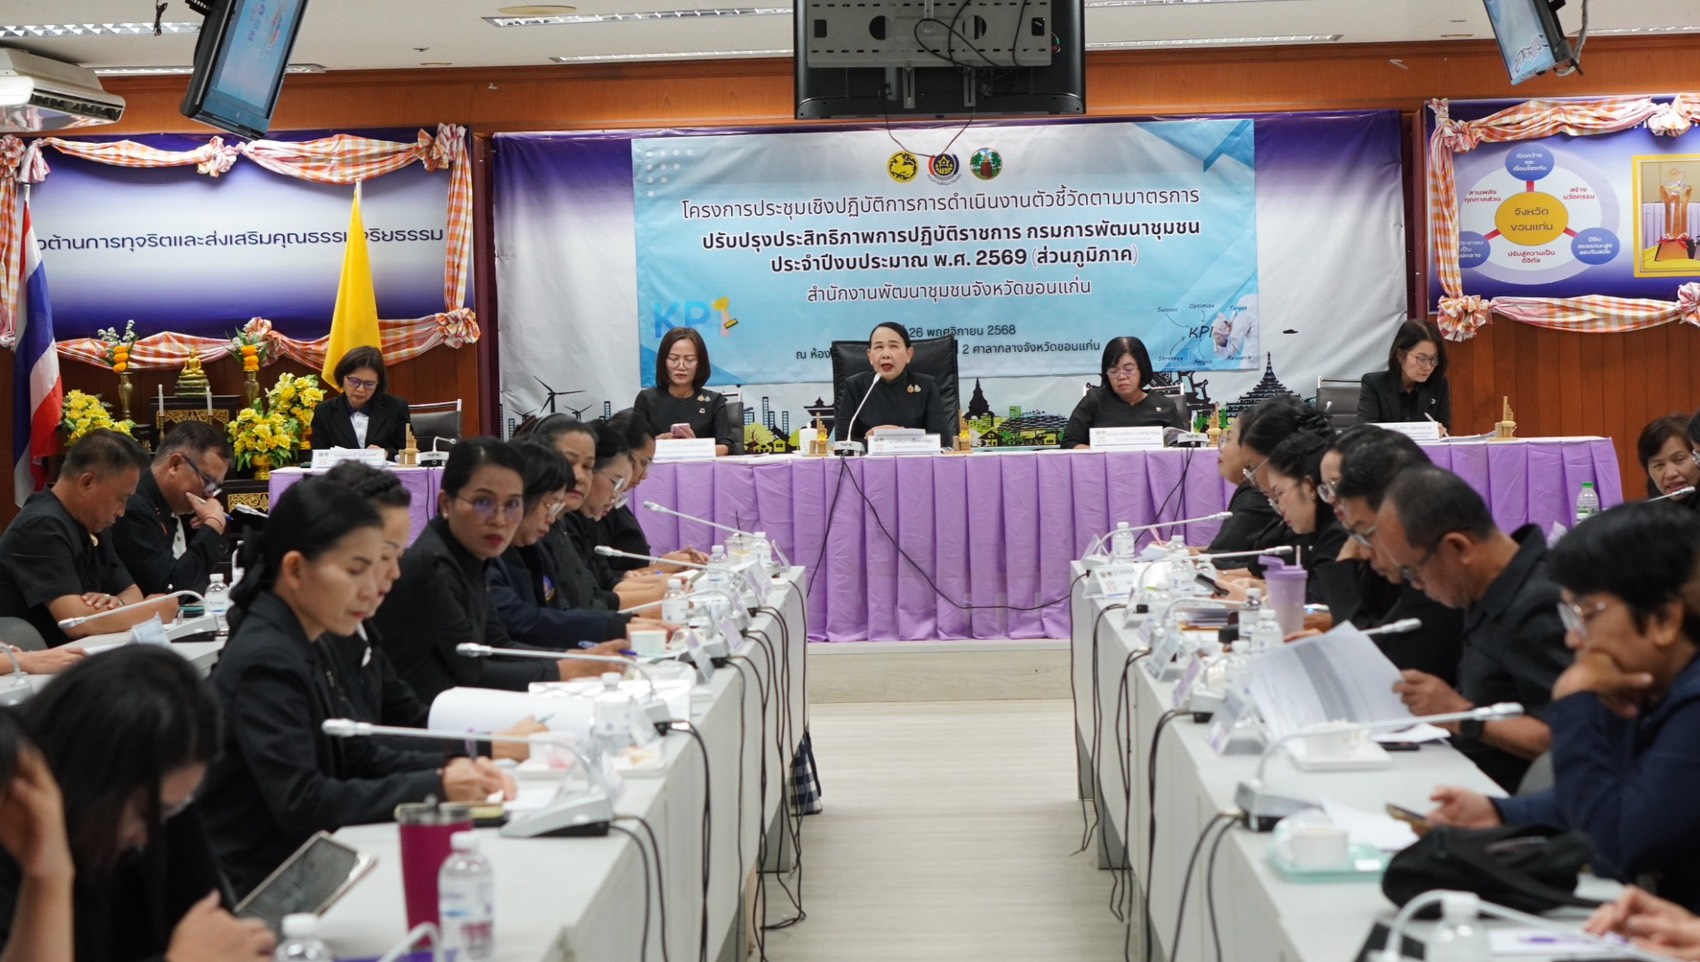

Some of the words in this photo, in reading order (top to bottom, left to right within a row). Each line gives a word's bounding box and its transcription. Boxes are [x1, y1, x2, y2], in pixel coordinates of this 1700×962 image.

[682, 184, 1200, 220] โครงการประชุมเชิงปฏิบัติการการดำเนินงานตัวชี้วัดตามมาตรการ
[1514, 206, 1549, 216] จังหวัด
[1510, 221, 1553, 232] ขอนแก่น
[702, 224, 1022, 252] ปรับปรุงประสิทธิภาพการปฏิบัติราชการ
[1027, 220, 1200, 240] กรมการพัฒนาชุมชน
[771, 253, 928, 273] ประจำปีงบประมาณ
[934, 255, 971, 268] พ.ศ.
[975, 249, 1027, 266] 2569
[1032, 245, 1138, 269] (ส่วนภูมิภาค)
[807, 276, 1091, 303] สำนักงานพัฒนาชุมชนจังหวัดขอนแก่น
[909, 327, 924, 338] 26
[987, 324, 1016, 336] 2568
[1188, 325, 1214, 339] KPI
[972, 340, 1101, 354] ศาลากลางจังหวัดขอนแก่น
[796, 350, 807, 360] ณ
